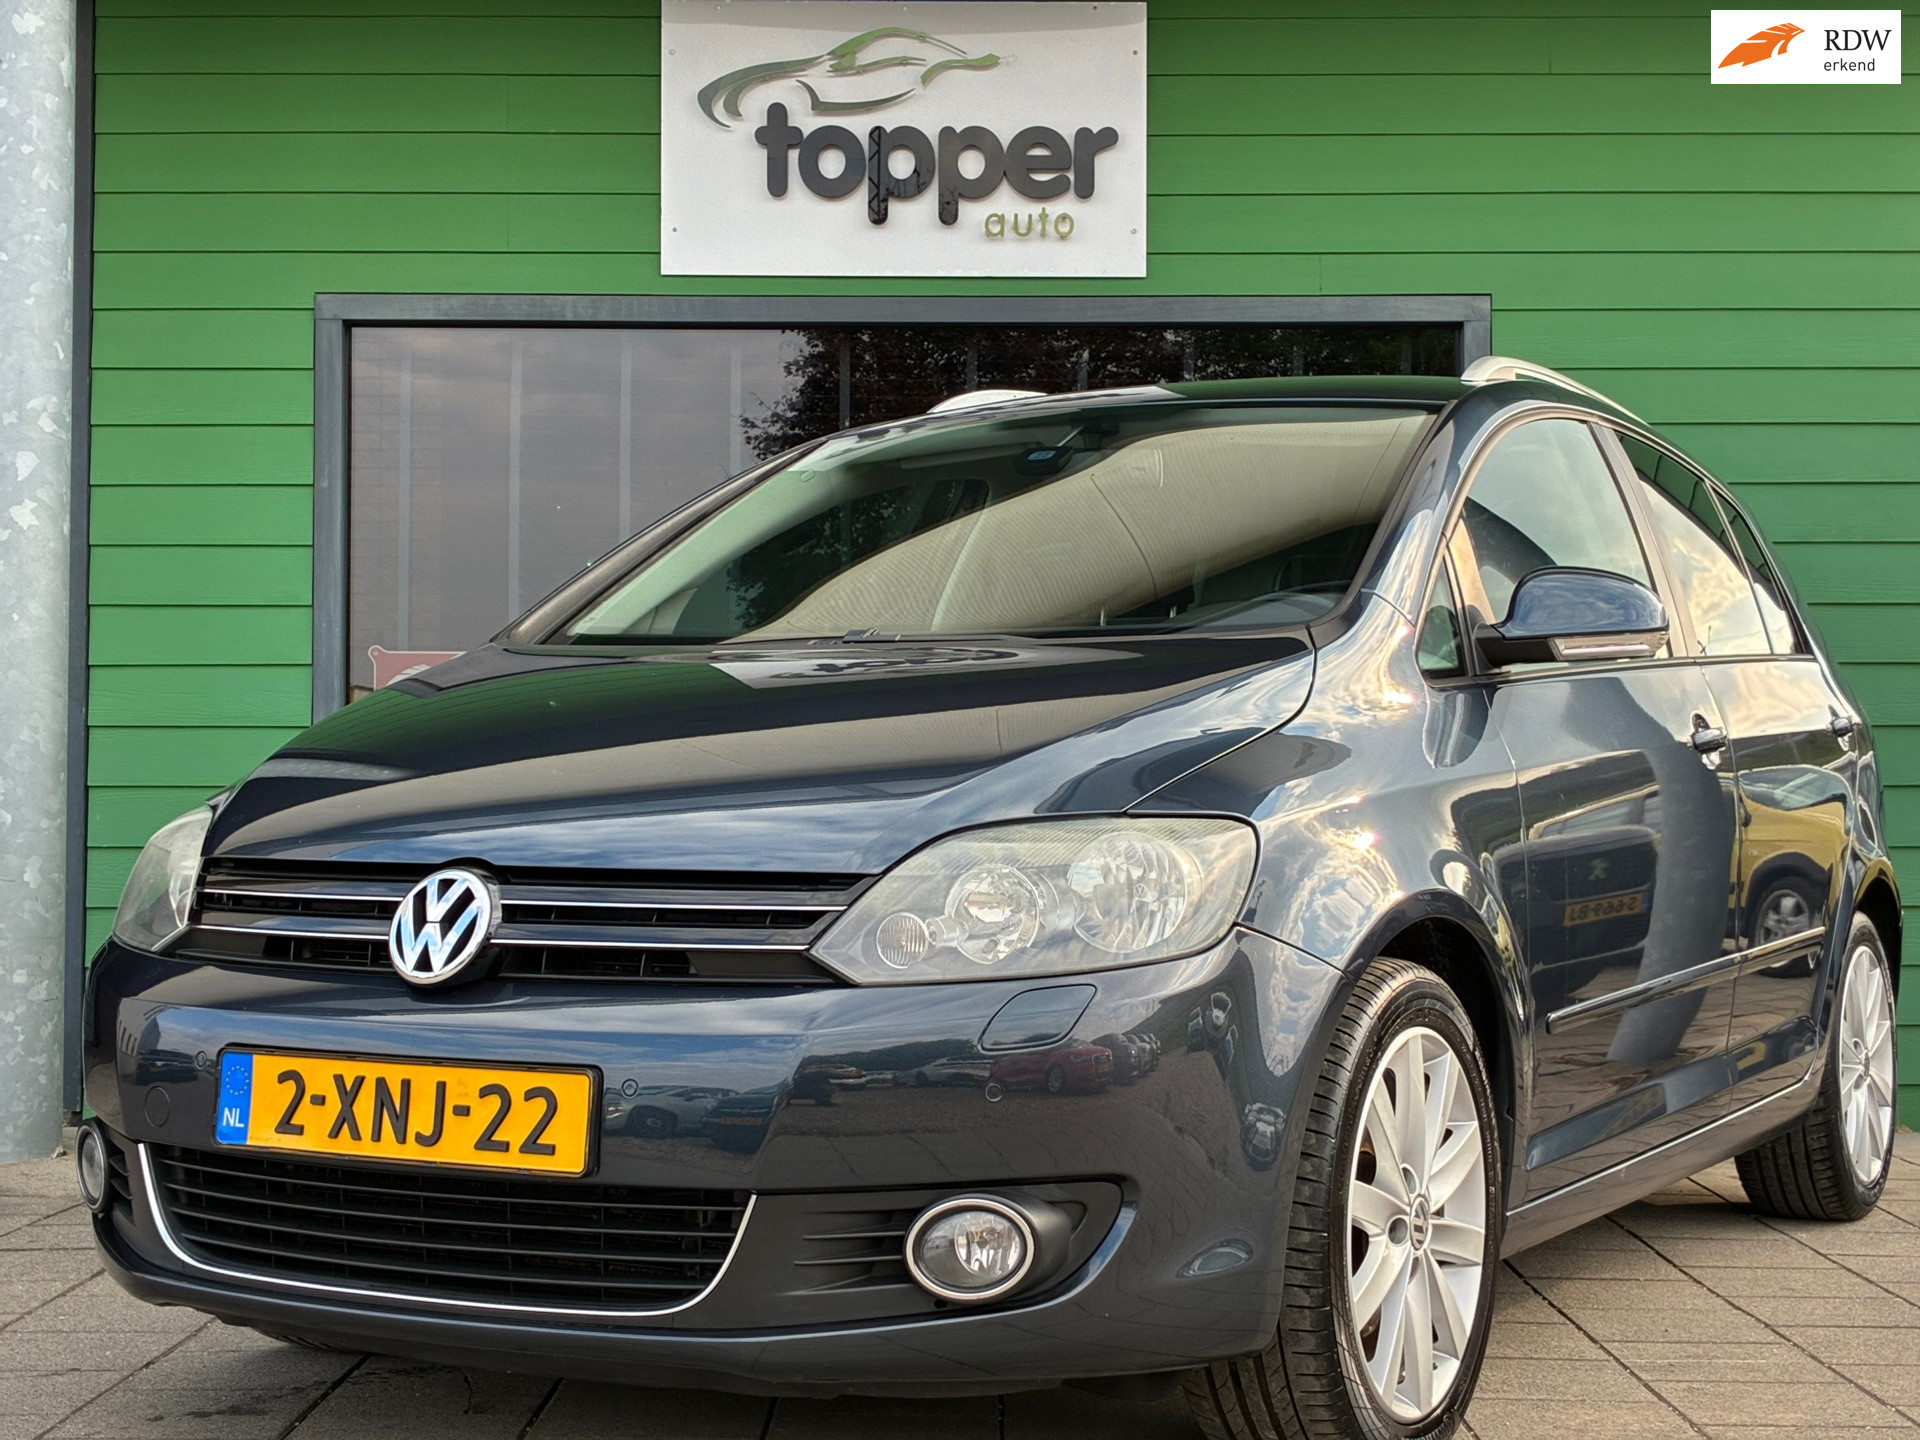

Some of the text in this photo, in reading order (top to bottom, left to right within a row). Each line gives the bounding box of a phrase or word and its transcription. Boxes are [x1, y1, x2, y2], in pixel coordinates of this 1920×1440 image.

[754, 102, 1119, 225] topper
[985, 206, 1074, 238] auto
[222, 1107, 245, 1128] NL
[274, 1069, 558, 1156] 2-XNJ-22
